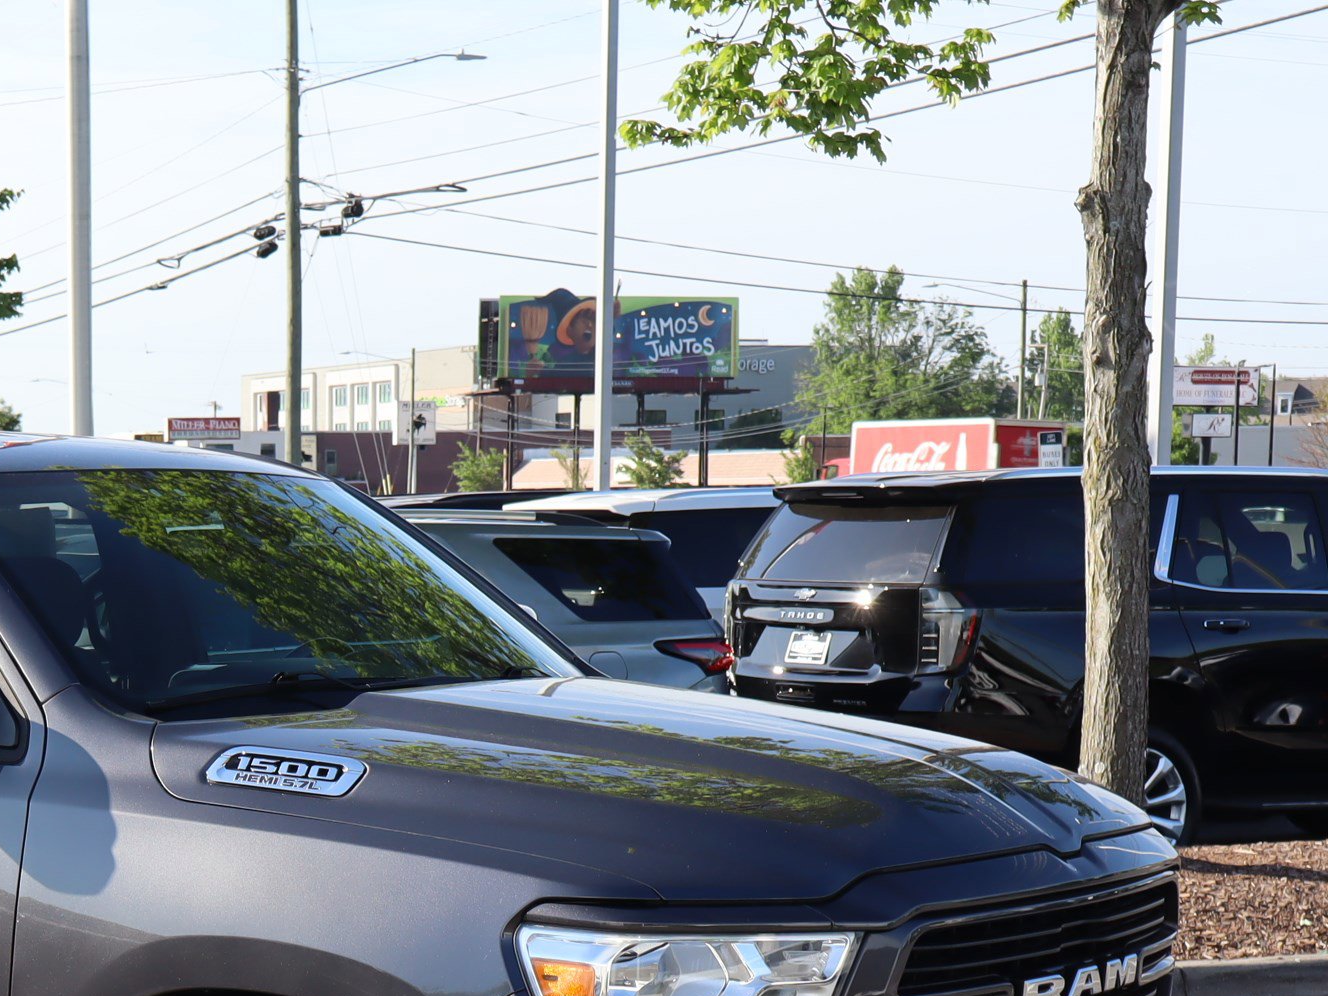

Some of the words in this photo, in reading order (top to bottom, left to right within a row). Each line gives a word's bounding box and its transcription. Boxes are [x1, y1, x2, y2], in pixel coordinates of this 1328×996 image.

[634, 315, 699, 339] LEAMOS
[644, 337, 715, 362] JUNTOS
[738, 359, 775, 374] orage
[172, 420, 206, 430] MILLER
[209, 419, 239, 429] PIANO
[780, 610, 825, 620] TAHOE
[236, 755, 339, 781] 1500
[234, 771, 278, 786] HEMI
[282, 778, 322, 791] 5.7L
